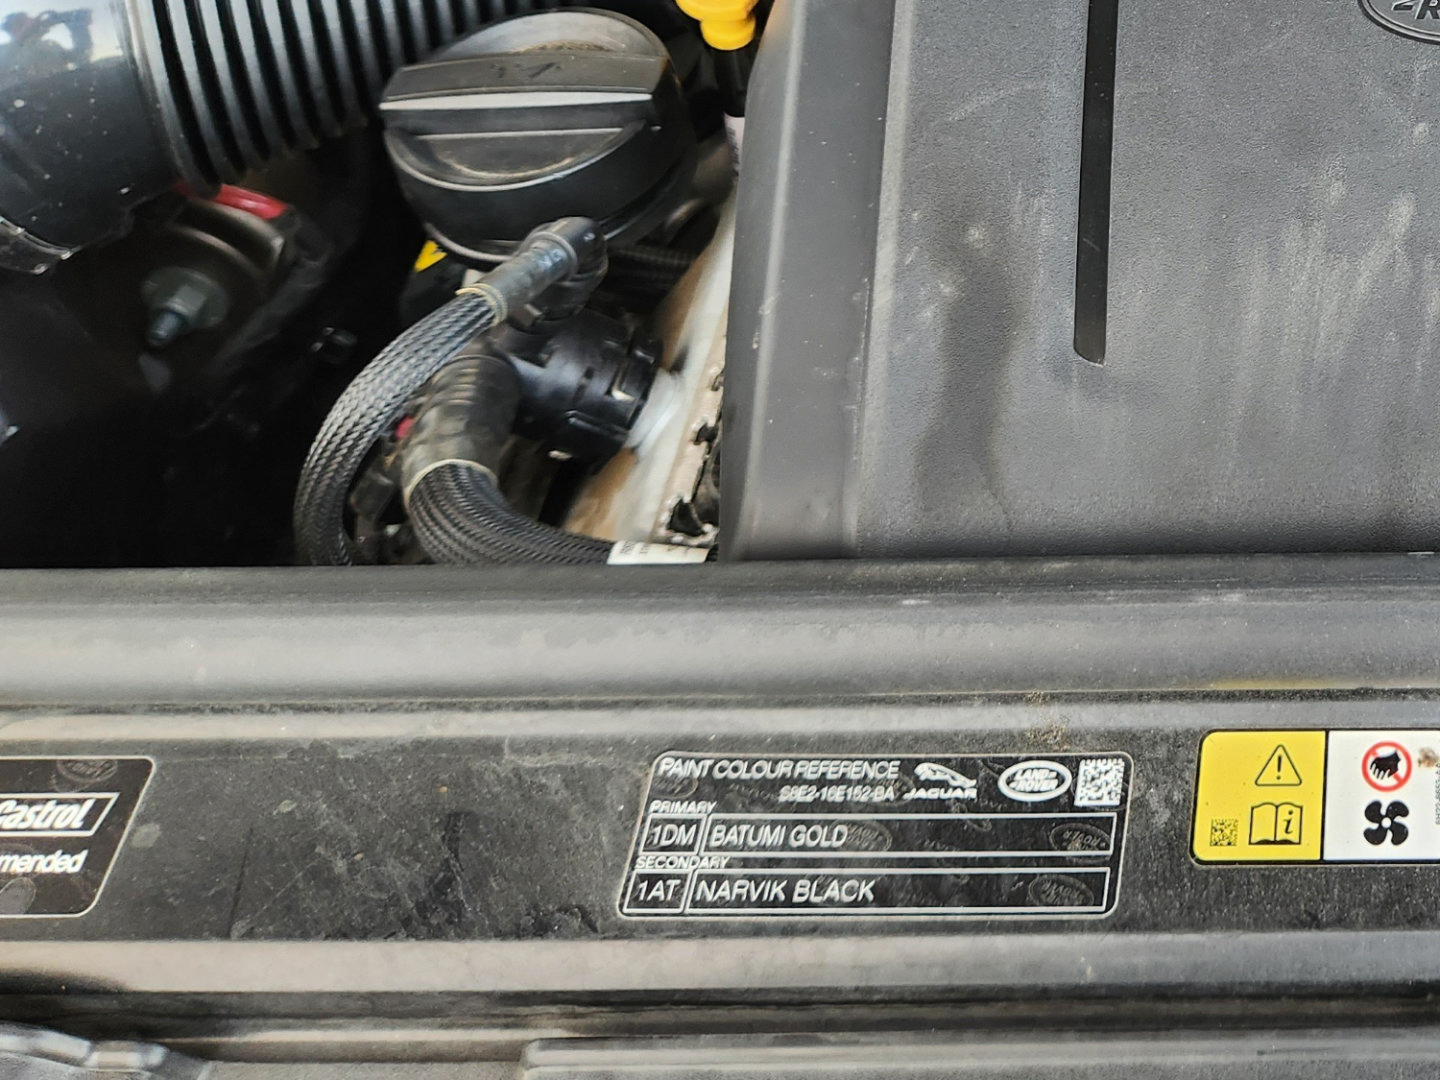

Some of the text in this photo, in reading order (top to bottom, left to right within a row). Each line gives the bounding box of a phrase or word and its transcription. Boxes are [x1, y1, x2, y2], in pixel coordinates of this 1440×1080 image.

[658, 758, 901, 780] PAINT COLOUR REFERENCE
[902, 787, 979, 801] JAGUAR
[648, 800, 718, 815] PRIMARY
[651, 824, 698, 846] 1DM
[709, 824, 786, 848] BATUMI
[788, 824, 849, 848] GOLD
[634, 856, 731, 870] SECONDARY
[637, 879, 682, 902] 1AT
[695, 879, 876, 904] NARVIK BLACK
